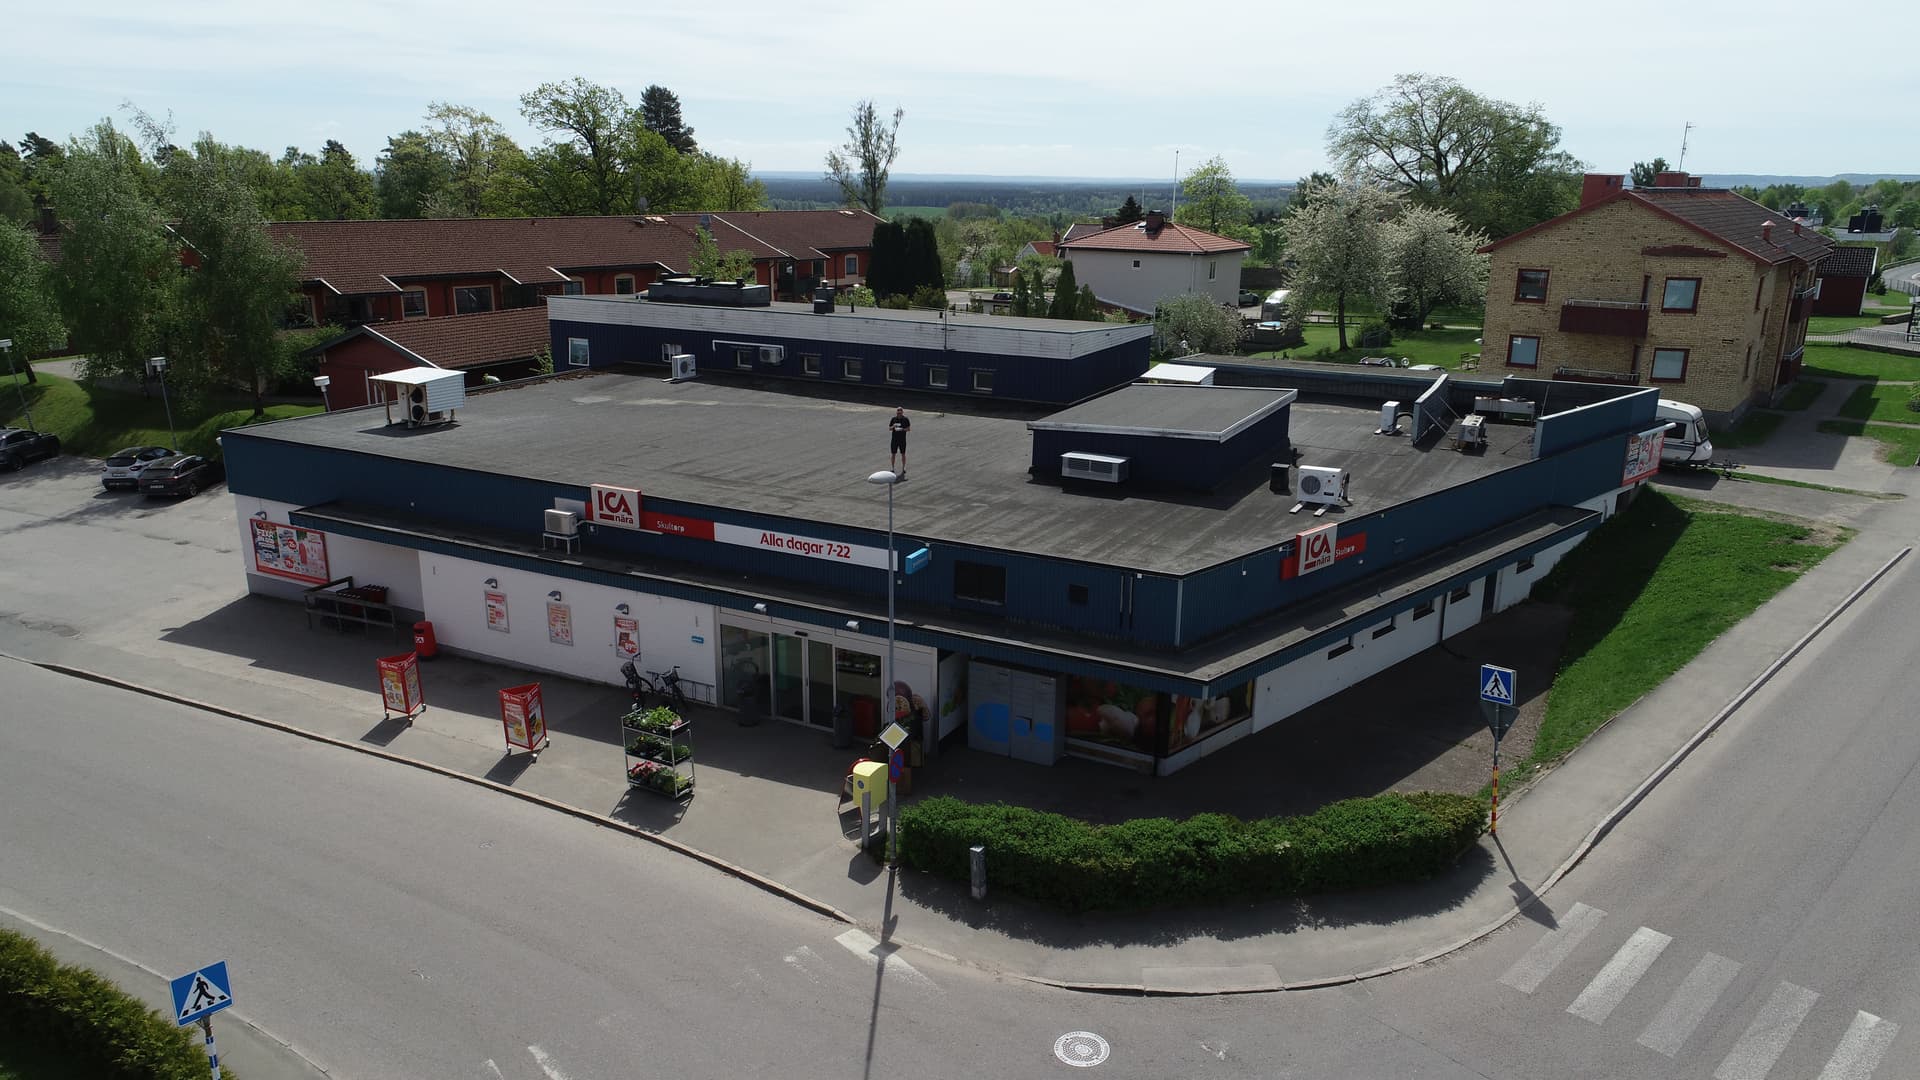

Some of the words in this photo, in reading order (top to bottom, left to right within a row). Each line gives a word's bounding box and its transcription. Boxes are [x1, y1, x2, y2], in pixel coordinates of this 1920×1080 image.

[597, 490, 632, 516] ICA
[614, 514, 634, 525] nära
[760, 532, 784, 547] Alla
[786, 536, 824, 555] dagar
[827, 543, 851, 559] 7-22
[1304, 533, 1331, 561] ICA
